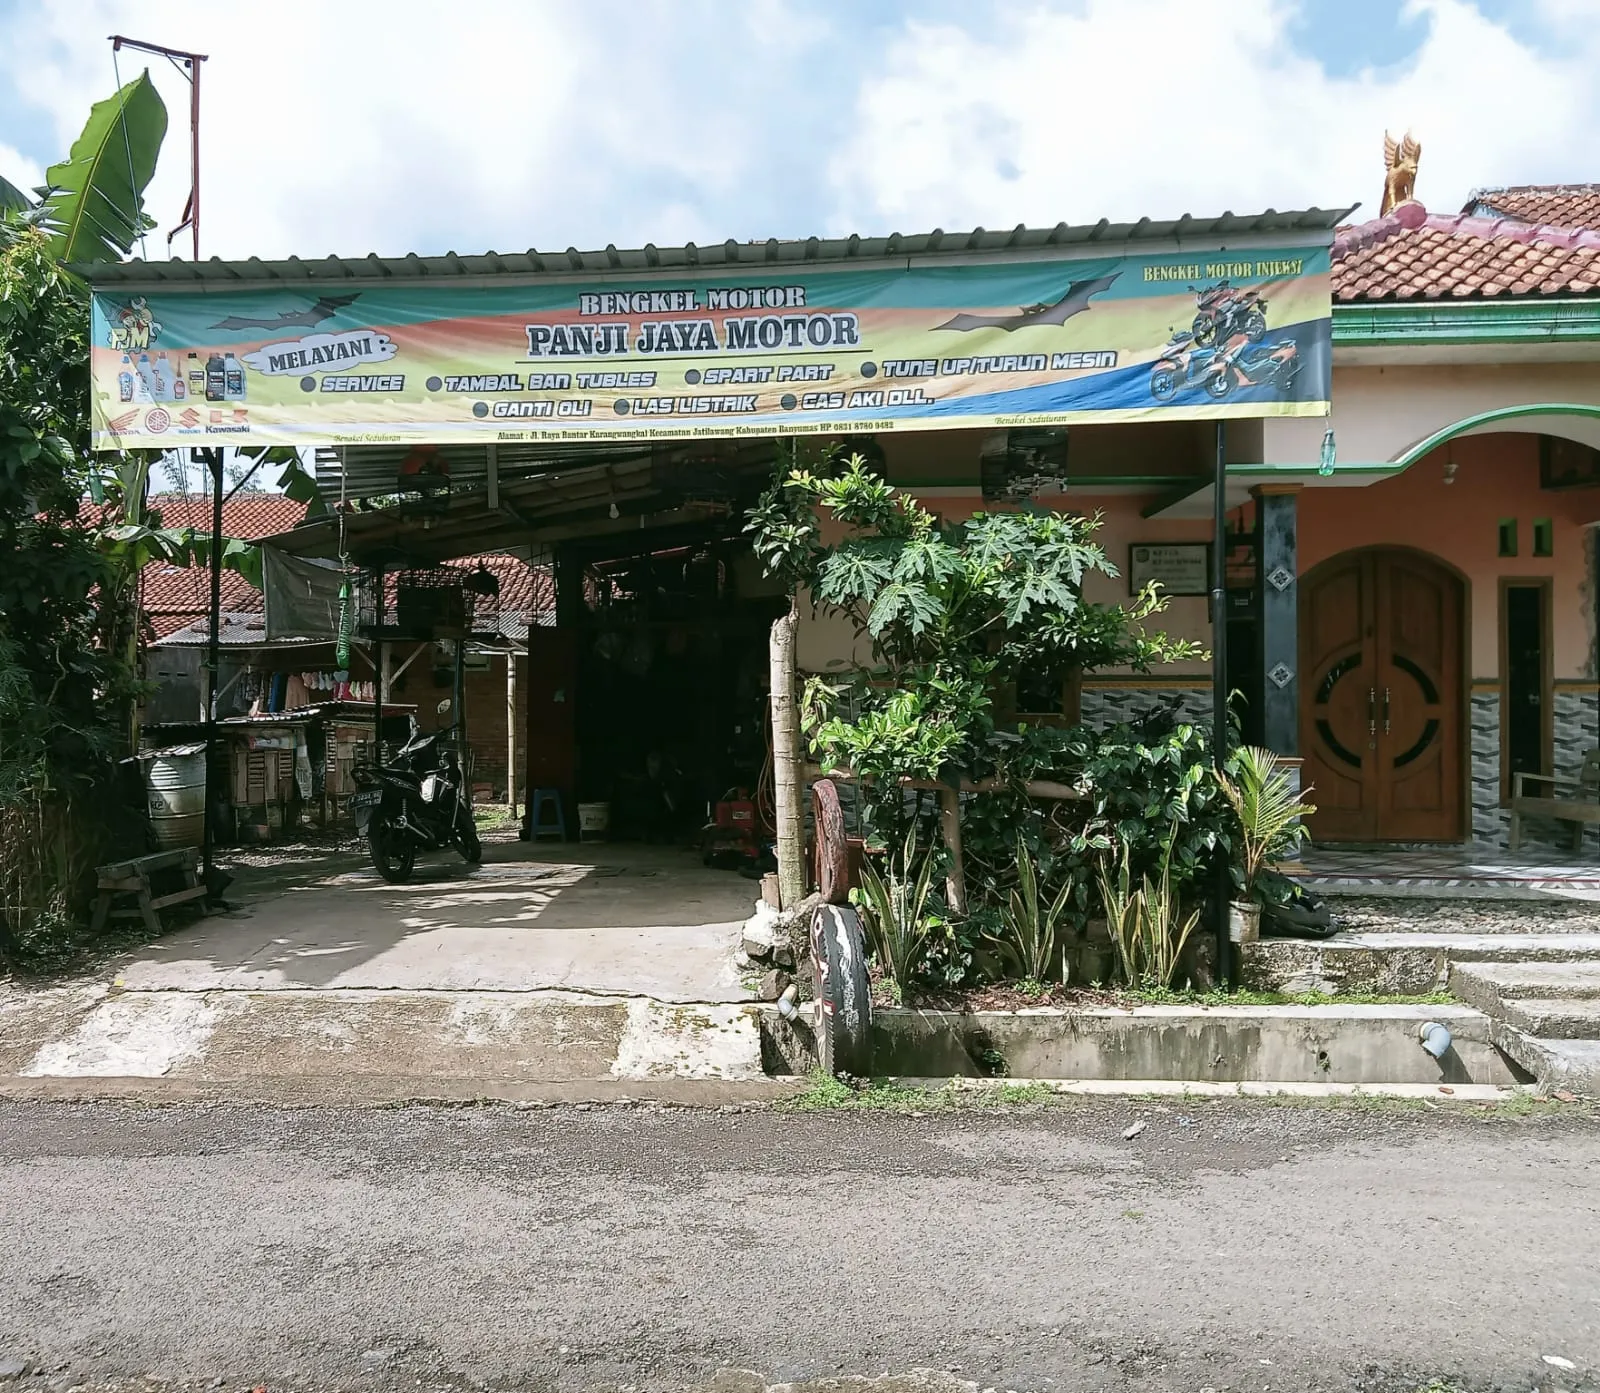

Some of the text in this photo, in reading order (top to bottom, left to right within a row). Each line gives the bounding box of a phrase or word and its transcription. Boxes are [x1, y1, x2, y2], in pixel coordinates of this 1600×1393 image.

[1143, 259, 1303, 281] BENGKEL MOTOR INJEKSI
[579, 286, 806, 315] BENGKEL MOTOR
[526, 314, 860, 357] PANJI JAYA MOTOR
[269, 338, 372, 372] MELAYANI
[882, 351, 1118, 377] TUNE UP/TURUN MESIN
[321, 375, 404, 392] SERVICE
[445, 372, 656, 391] TAMBAL BAN TUBLES
[703, 365, 834, 384] SPART PART
[493, 400, 591, 417] GANTI OLI
[633, 395, 757, 414] LAS LISTRIK
[802, 389, 935, 409] CAS AKI DLL.
[205, 425, 250, 434] Kawasaki
[497, 432, 524, 440] Alamat
[530, 431, 540, 439] Jl.
[541, 431, 561, 440] Raya
[562, 430, 588, 439] Bantar
[649, 428, 692, 437] Kecamatan
[692, 426, 734, 436] Jatilawang
[735, 426, 777, 435] Kabupaten
[779, 424, 818, 434] Banyumas
